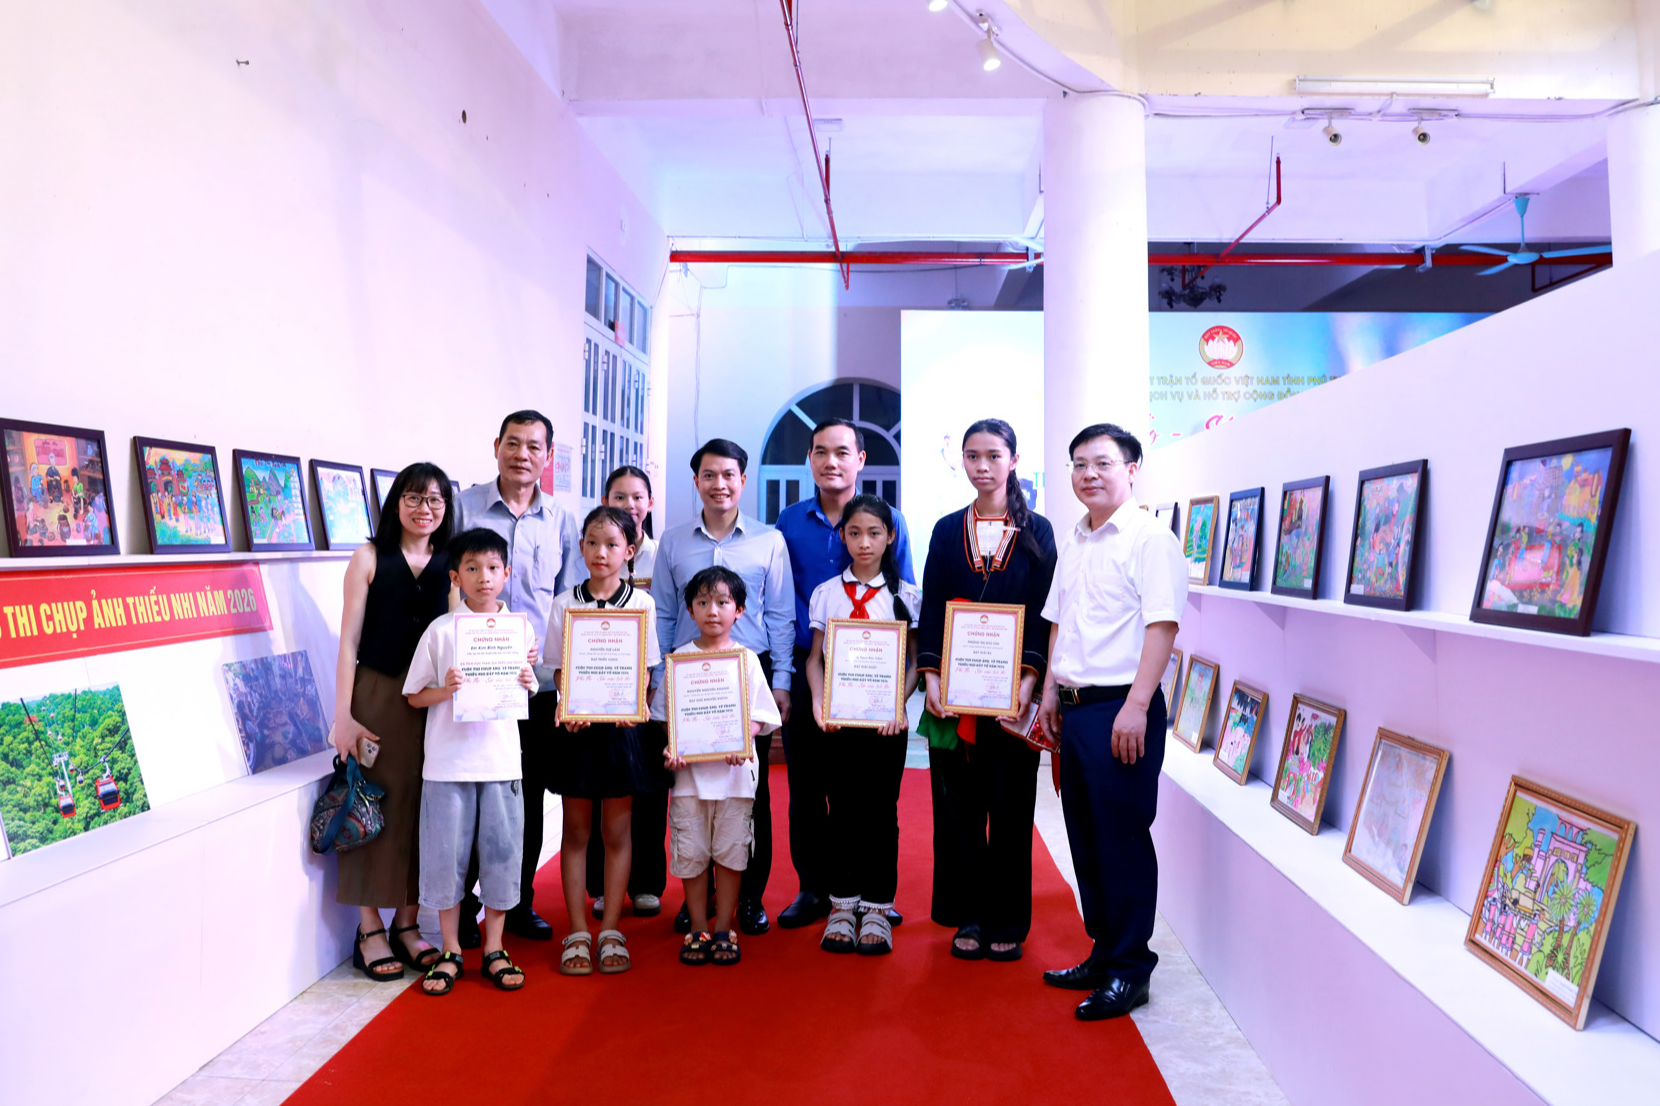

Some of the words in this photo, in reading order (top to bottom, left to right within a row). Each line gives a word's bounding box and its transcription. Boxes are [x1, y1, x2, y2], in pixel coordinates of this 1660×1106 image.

[1157, 374, 1182, 387] TRẬN
[1185, 372, 1197, 385] TỔ
[1201, 373, 1231, 385] QUỐC
[1234, 374, 1254, 387] VIỆT
[1257, 376, 1279, 385] NAM
[1282, 374, 1304, 385] TỈNH
[1308, 374, 1327, 385] PHÚ
[1170, 391, 1183, 402] VỤ
[1186, 389, 1200, 400] VÀ
[1204, 388, 1218, 400] HỖ
[1222, 391, 1241, 402] TRỢ
[1243, 390, 1274, 402] CỘNG
[4, 605, 38, 639] THI
[39, 600, 88, 639] CHỤP
[91, 589, 127, 630] ẢNH
[126, 586, 171, 624] THIẾU
[171, 592, 197, 620] NHI
[196, 586, 228, 617] NĂM
[227, 588, 257, 614] 2026
